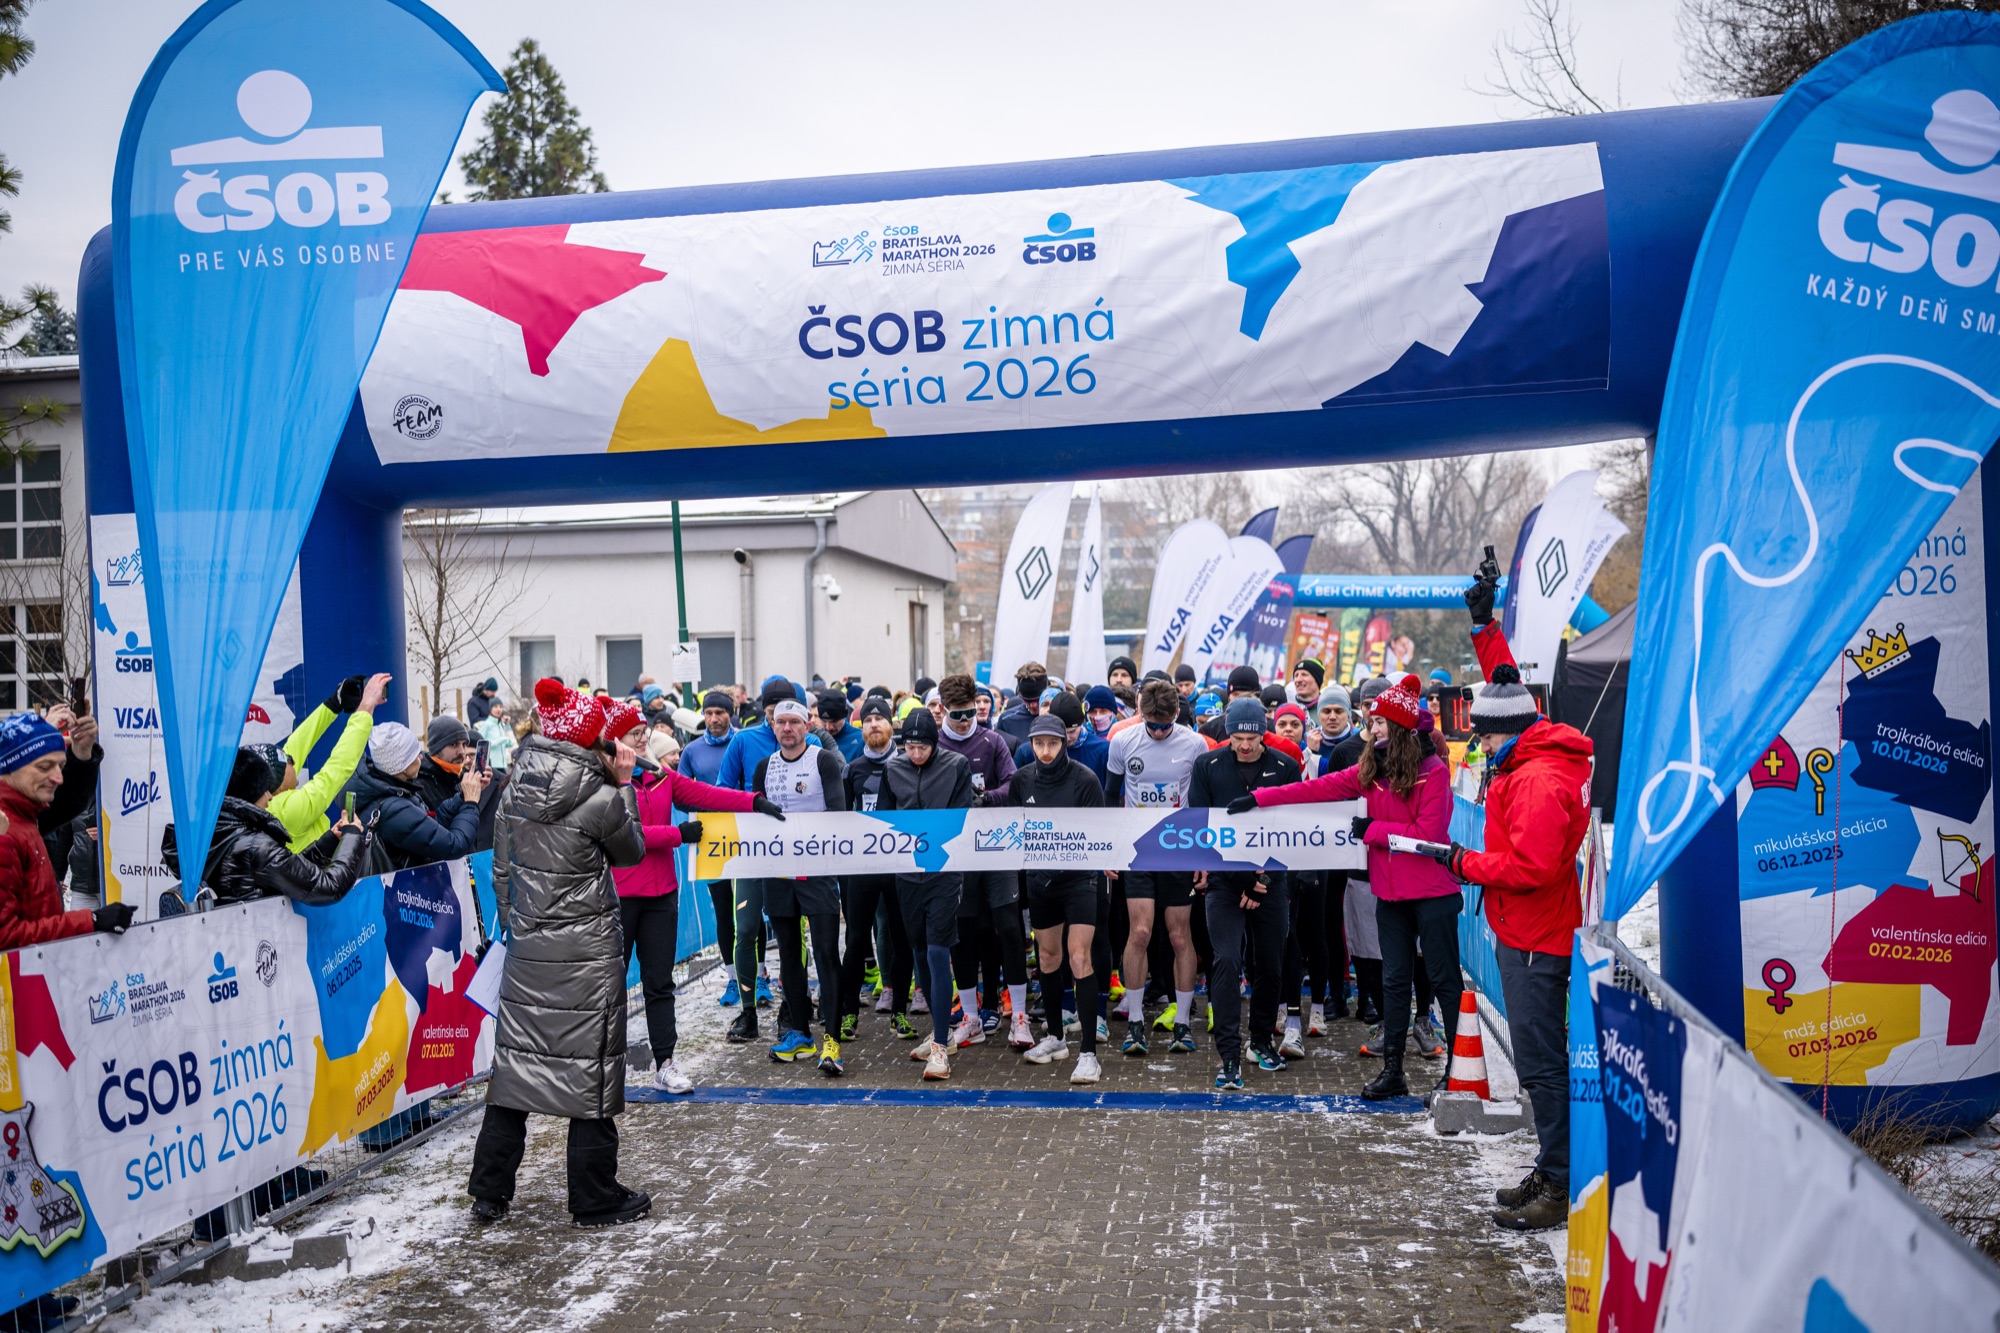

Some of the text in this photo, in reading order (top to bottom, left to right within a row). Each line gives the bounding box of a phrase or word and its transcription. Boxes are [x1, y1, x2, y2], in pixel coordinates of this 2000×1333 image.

[174, 169, 392, 233] ČSOB
[882, 234, 962, 249] BRATISLAVA
[883, 226, 919, 236] ČSOB
[1818, 173, 2000, 294] ČSO
[179, 242, 396, 273] PRE VÁS OSOBNE
[882, 244, 996, 263] MARATHON 2026
[882, 258, 965, 276] ZIMNÁ SÉRIA
[1022, 242, 1097, 265] ČSOB
[1806, 273, 2000, 337] KAŽDÝ DEŇ SM
[798, 296, 1115, 360] ČSOB zimná
[828, 353, 1097, 410] séria 2026
[392, 404, 443, 434] TEAM
[1315, 584, 1466, 598] BEH CÍTIME VŠETCI ROVN
[1884, 563, 1957, 597] 026
[1154, 606, 1192, 654] VISA
[1196, 614, 1234, 656] VISA
[116, 656, 153, 673] ČSOB
[113, 707, 159, 730] VISA
[1872, 739, 1949, 774] 10.01.2026
[1876, 722, 1984, 768] trojkráľová edícia
[122, 771, 161, 809] Cool
[1141, 791, 1166, 803] 806
[1024, 820, 1053, 830] ČSOB
[1024, 832, 1086, 841] BRATISLAVA
[1158, 823, 1236, 850] ČSOB
[1245, 825, 1324, 848] zimná
[1754, 817, 1888, 856] mikulášska edícia
[708, 832, 930, 858] zimná séria 2026
[1024, 842, 1112, 852] MARATHON 2026
[1024, 851, 1088, 861] ZIMNÁ SÉRIA
[1758, 844, 1844, 873] 06.12.2025
[1871, 925, 1988, 946] valentínska edícia
[1868, 942, 1953, 964] 07.02.2026
[126, 973, 146, 987] ČSOB
[128, 980, 168, 1000] BRATISLAVA
[326, 955, 362, 998] 06.12.2025
[130, 989, 186, 1014] MARATHON 2026
[208, 980, 239, 1005] ČSOB
[1782, 1012, 1867, 1041] mdž edícia
[1788, 1026, 1878, 1058] 07.03.2026
[98, 1019, 294, 1133] ČSOB zimná
[124, 1083, 288, 1200] séria 2026
